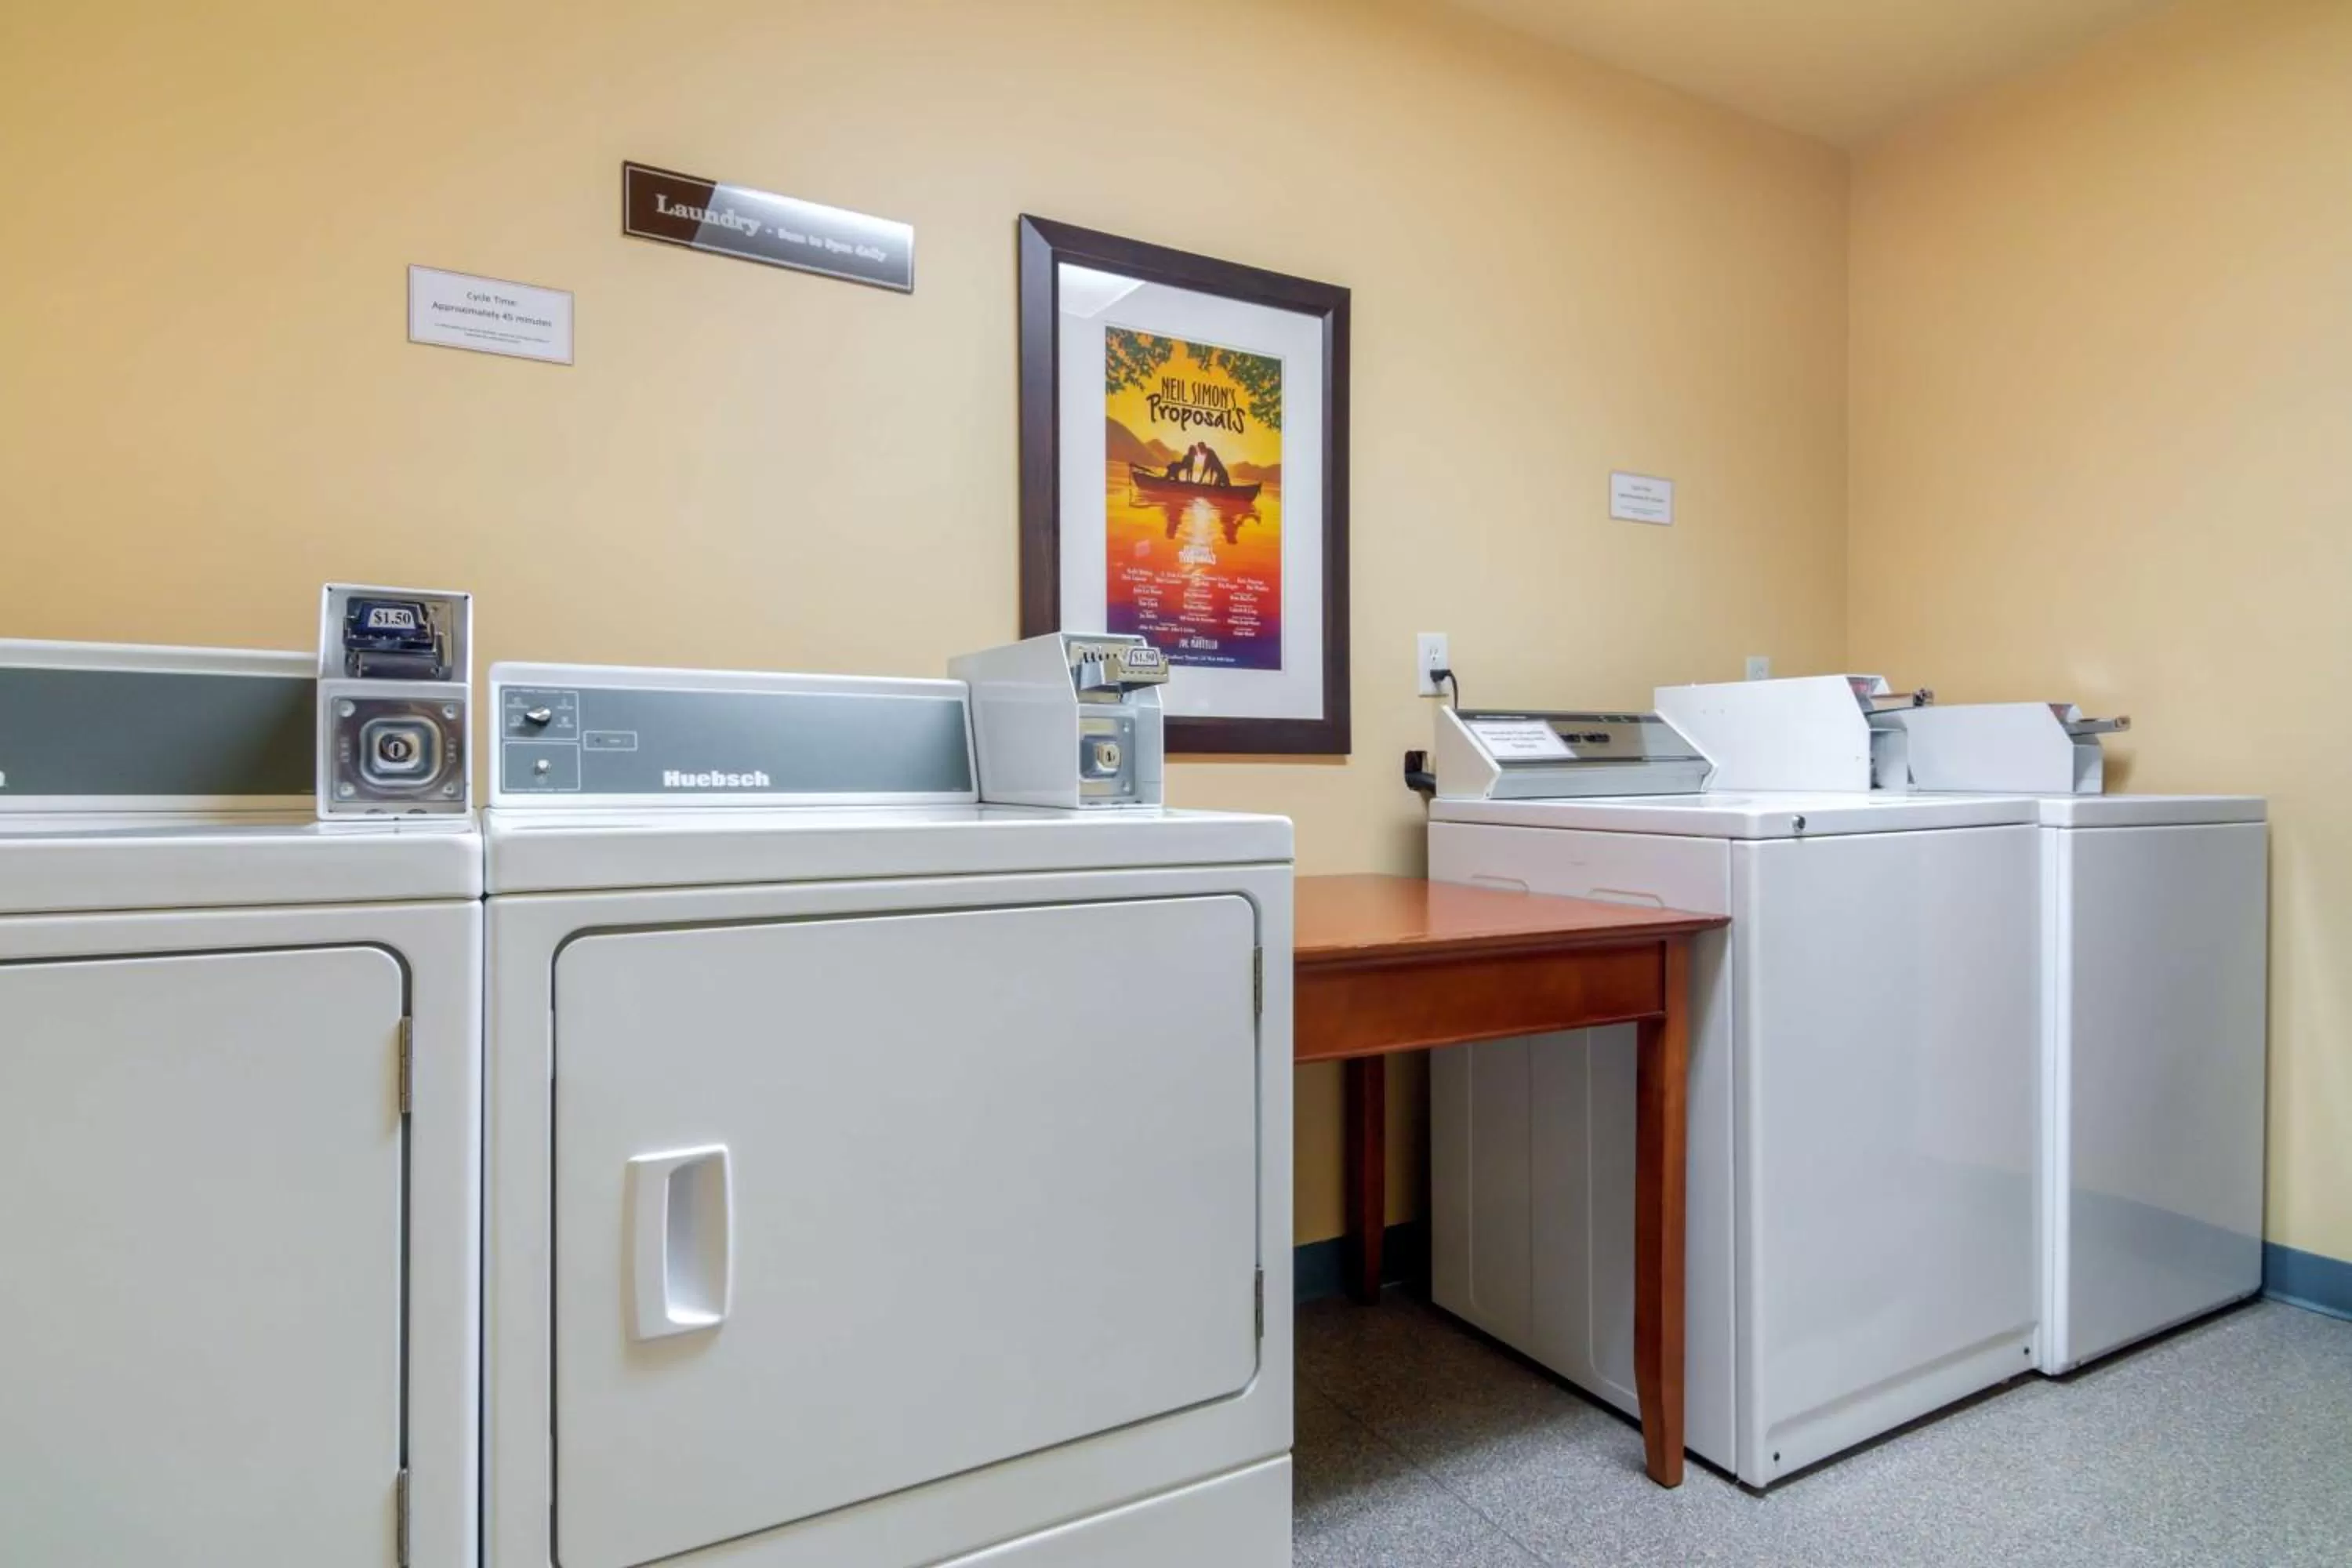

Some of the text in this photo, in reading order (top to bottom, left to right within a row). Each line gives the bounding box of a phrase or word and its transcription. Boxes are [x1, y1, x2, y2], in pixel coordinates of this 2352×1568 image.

[655, 193, 761, 237] Laundry
[855, 244, 887, 263] daily
[466, 291, 491, 303] Cycle
[431, 300, 499, 321] Approximately
[515, 315, 553, 328] minutes
[1161, 376, 1237, 410] NEIL SIMON'S
[1146, 392, 1246, 434] Proposals
[373, 610, 412, 626] $1.50
[662, 768, 771, 788] Huebsch
